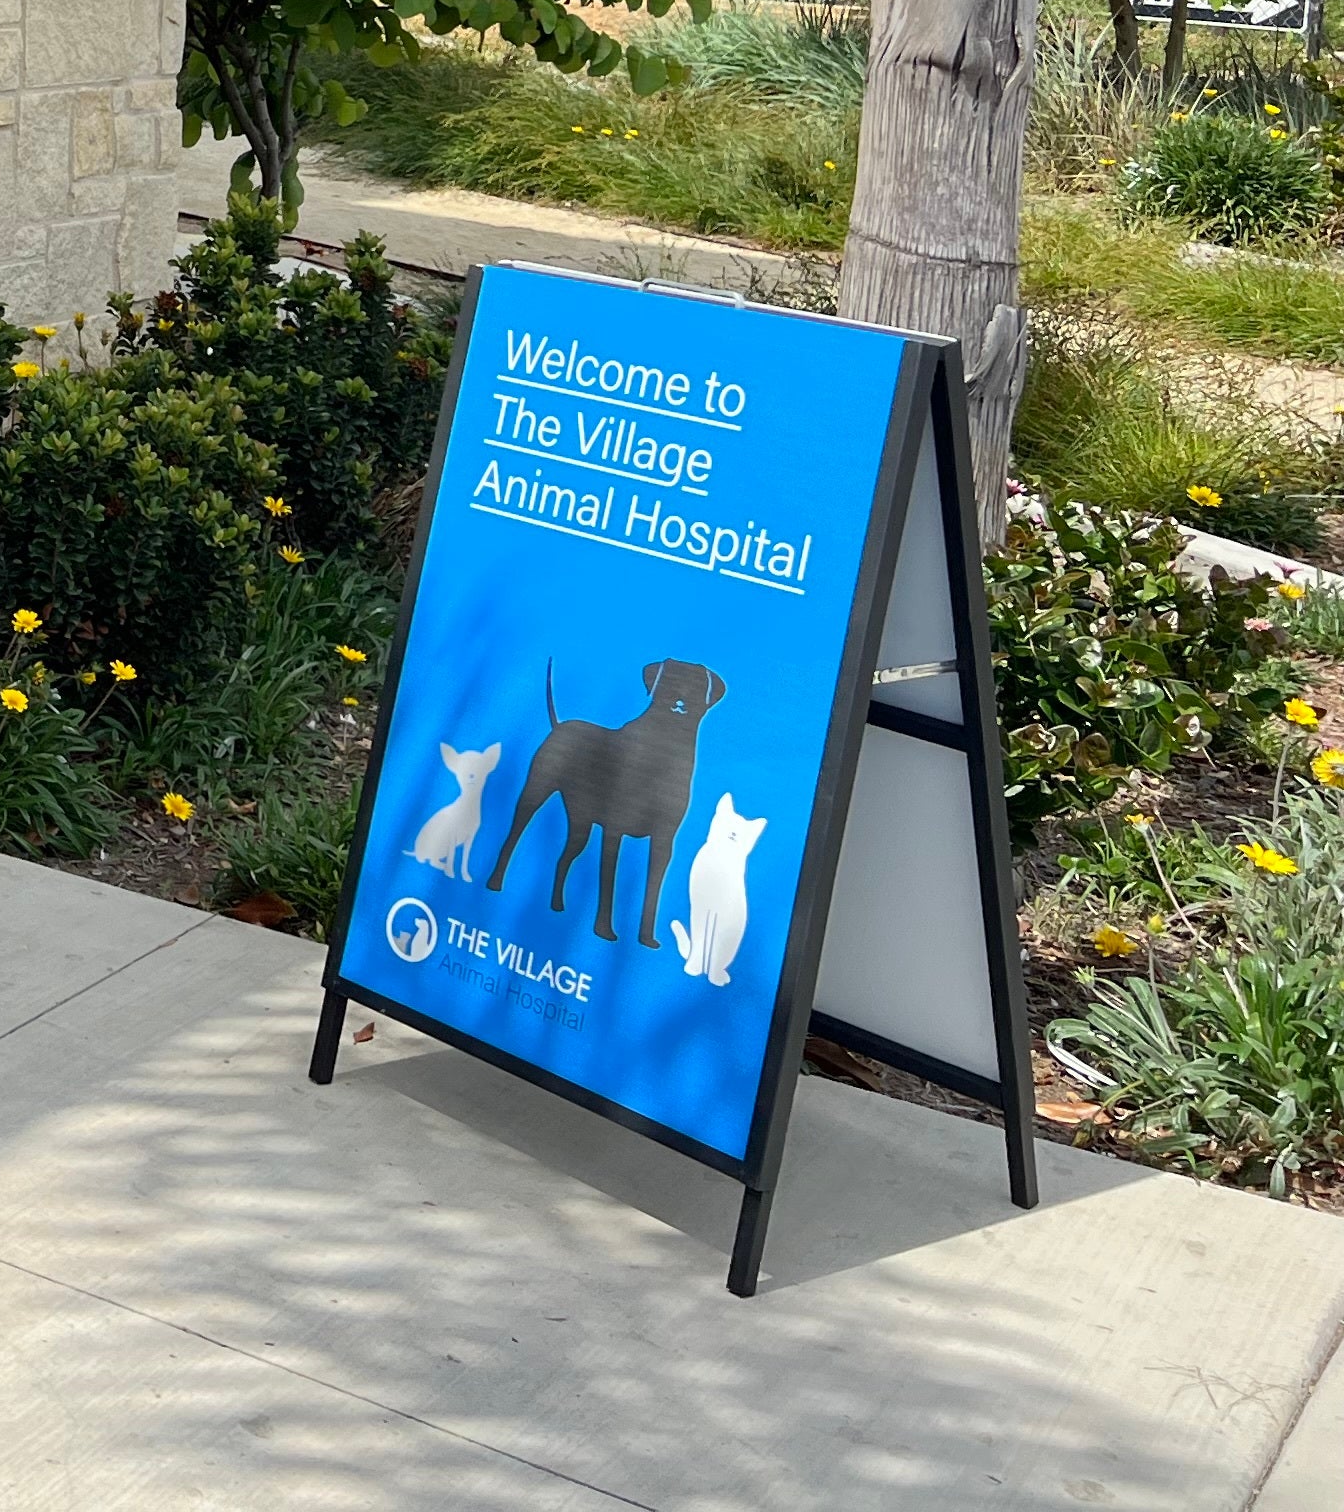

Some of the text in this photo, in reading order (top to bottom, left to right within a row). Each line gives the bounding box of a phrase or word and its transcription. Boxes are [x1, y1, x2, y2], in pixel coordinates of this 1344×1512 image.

[504, 330, 748, 419] Welcome to
[492, 394, 714, 486] The Village
[473, 460, 813, 583] Animal Hospital
[438, 952, 585, 1033] Animal Hospital
[447, 917, 593, 1003] THE VILLAGE
